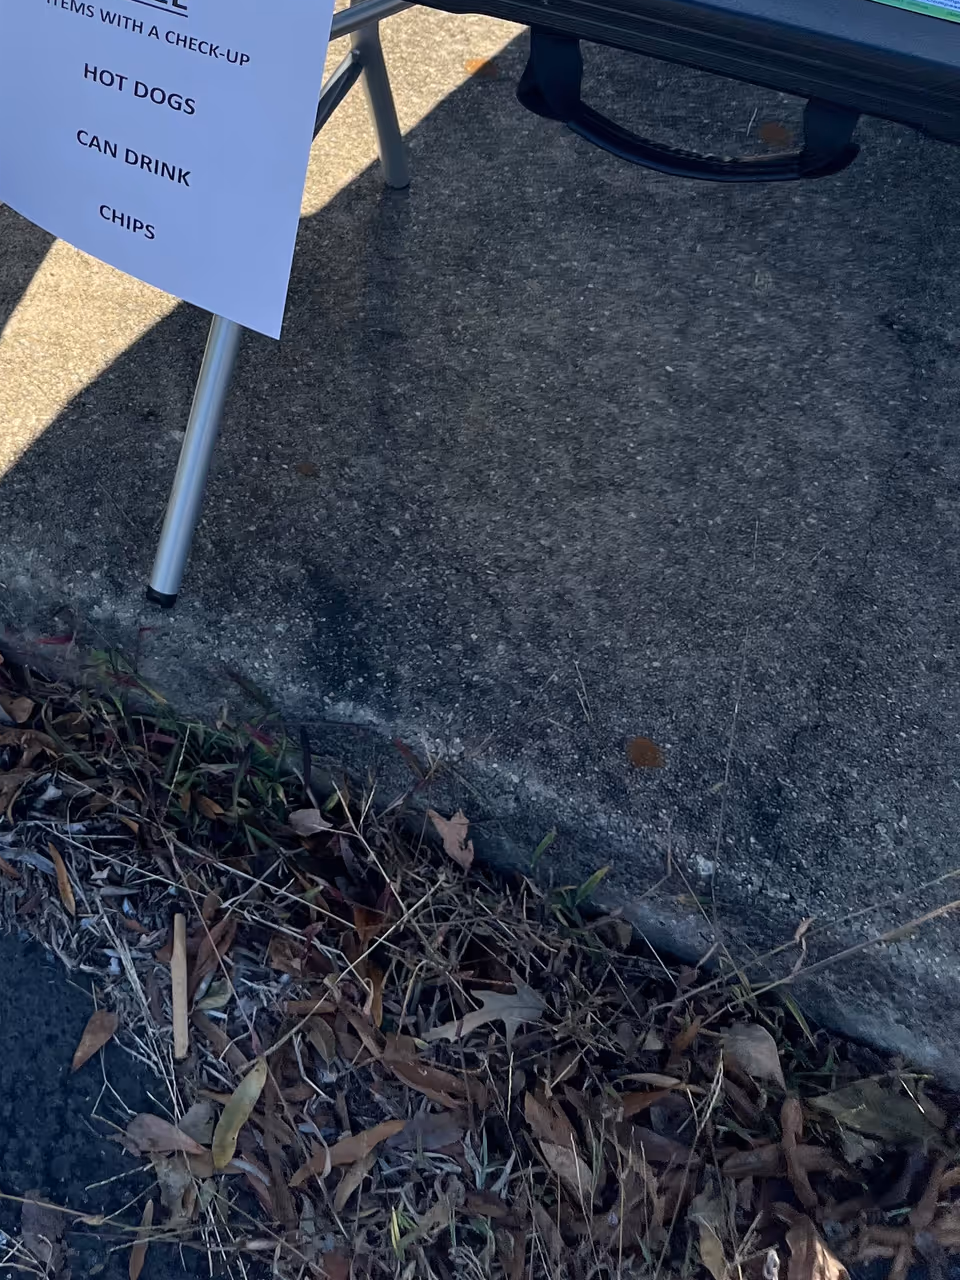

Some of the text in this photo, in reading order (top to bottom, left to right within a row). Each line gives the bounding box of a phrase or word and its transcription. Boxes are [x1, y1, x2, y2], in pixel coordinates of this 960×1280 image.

[99, 8, 143, 34] WITH
[147, 25, 160, 40] A
[165, 30, 250, 66] CHECK-UP
[83, 63, 196, 115] HOT DOGS
[76, 129, 191, 187] CAN DRINK
[99, 204, 155, 240] CHIPS
